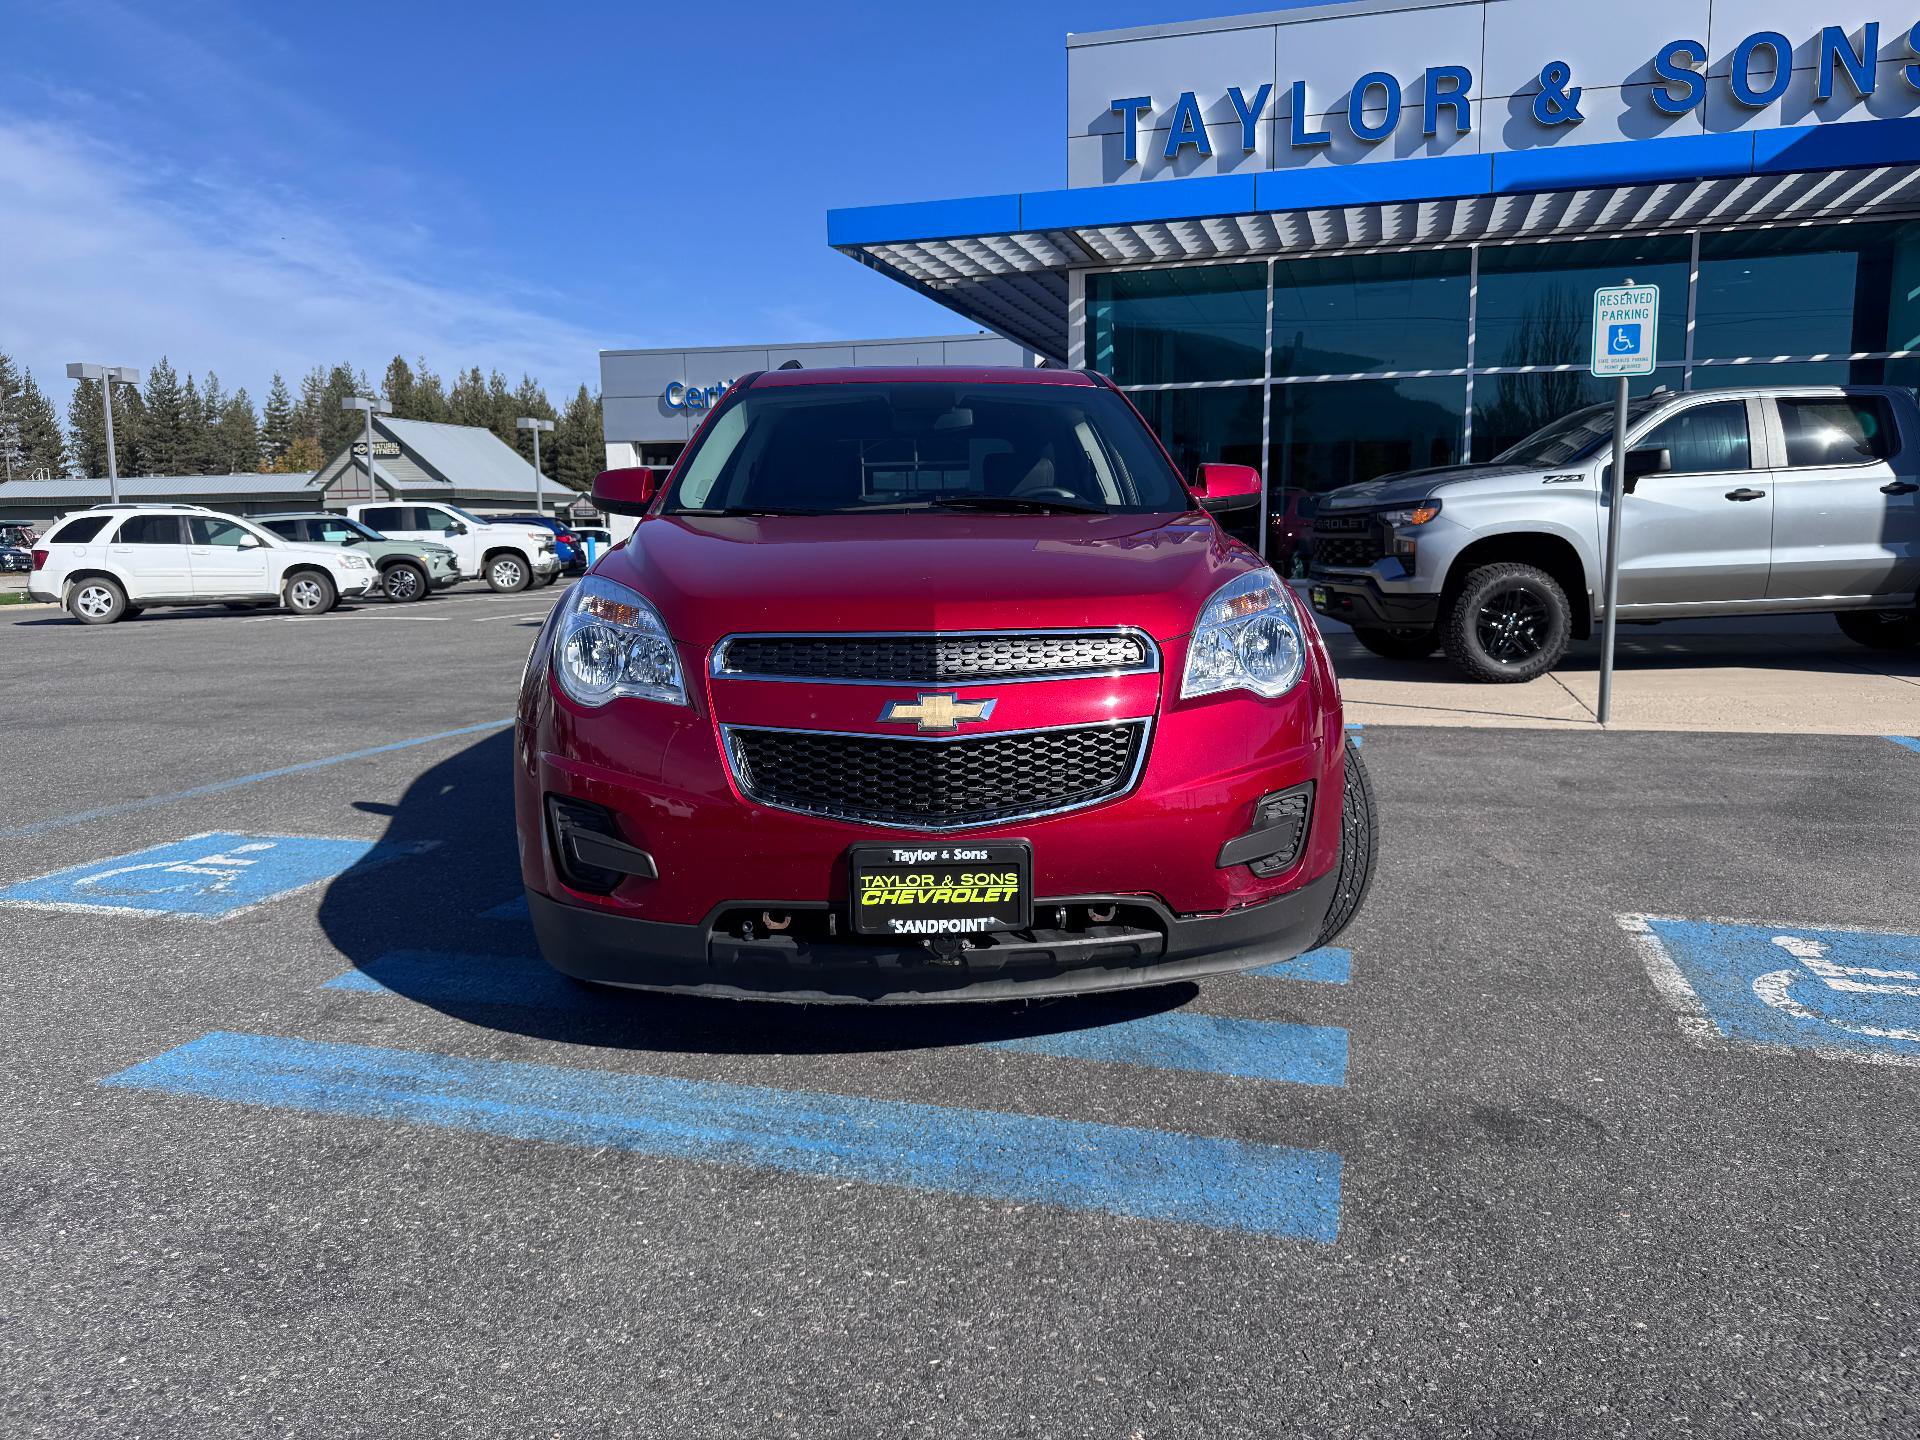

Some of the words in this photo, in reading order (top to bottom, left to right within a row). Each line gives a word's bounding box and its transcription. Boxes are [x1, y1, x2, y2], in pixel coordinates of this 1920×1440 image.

[1111, 64, 1473, 164] TAYLOR
[1532, 60, 1585, 127] &
[1600, 292, 1653, 306] RESERVED
[1602, 308, 1649, 320] PARKING
[892, 849, 938, 864] Taylor
[941, 850, 950, 859] &
[953, 848, 988, 860] Sons
[861, 874, 934, 888] TAYLOR
[941, 875, 954, 889] &
[960, 873, 1018, 886] SONS
[861, 888, 1019, 906] CHEVROLET
